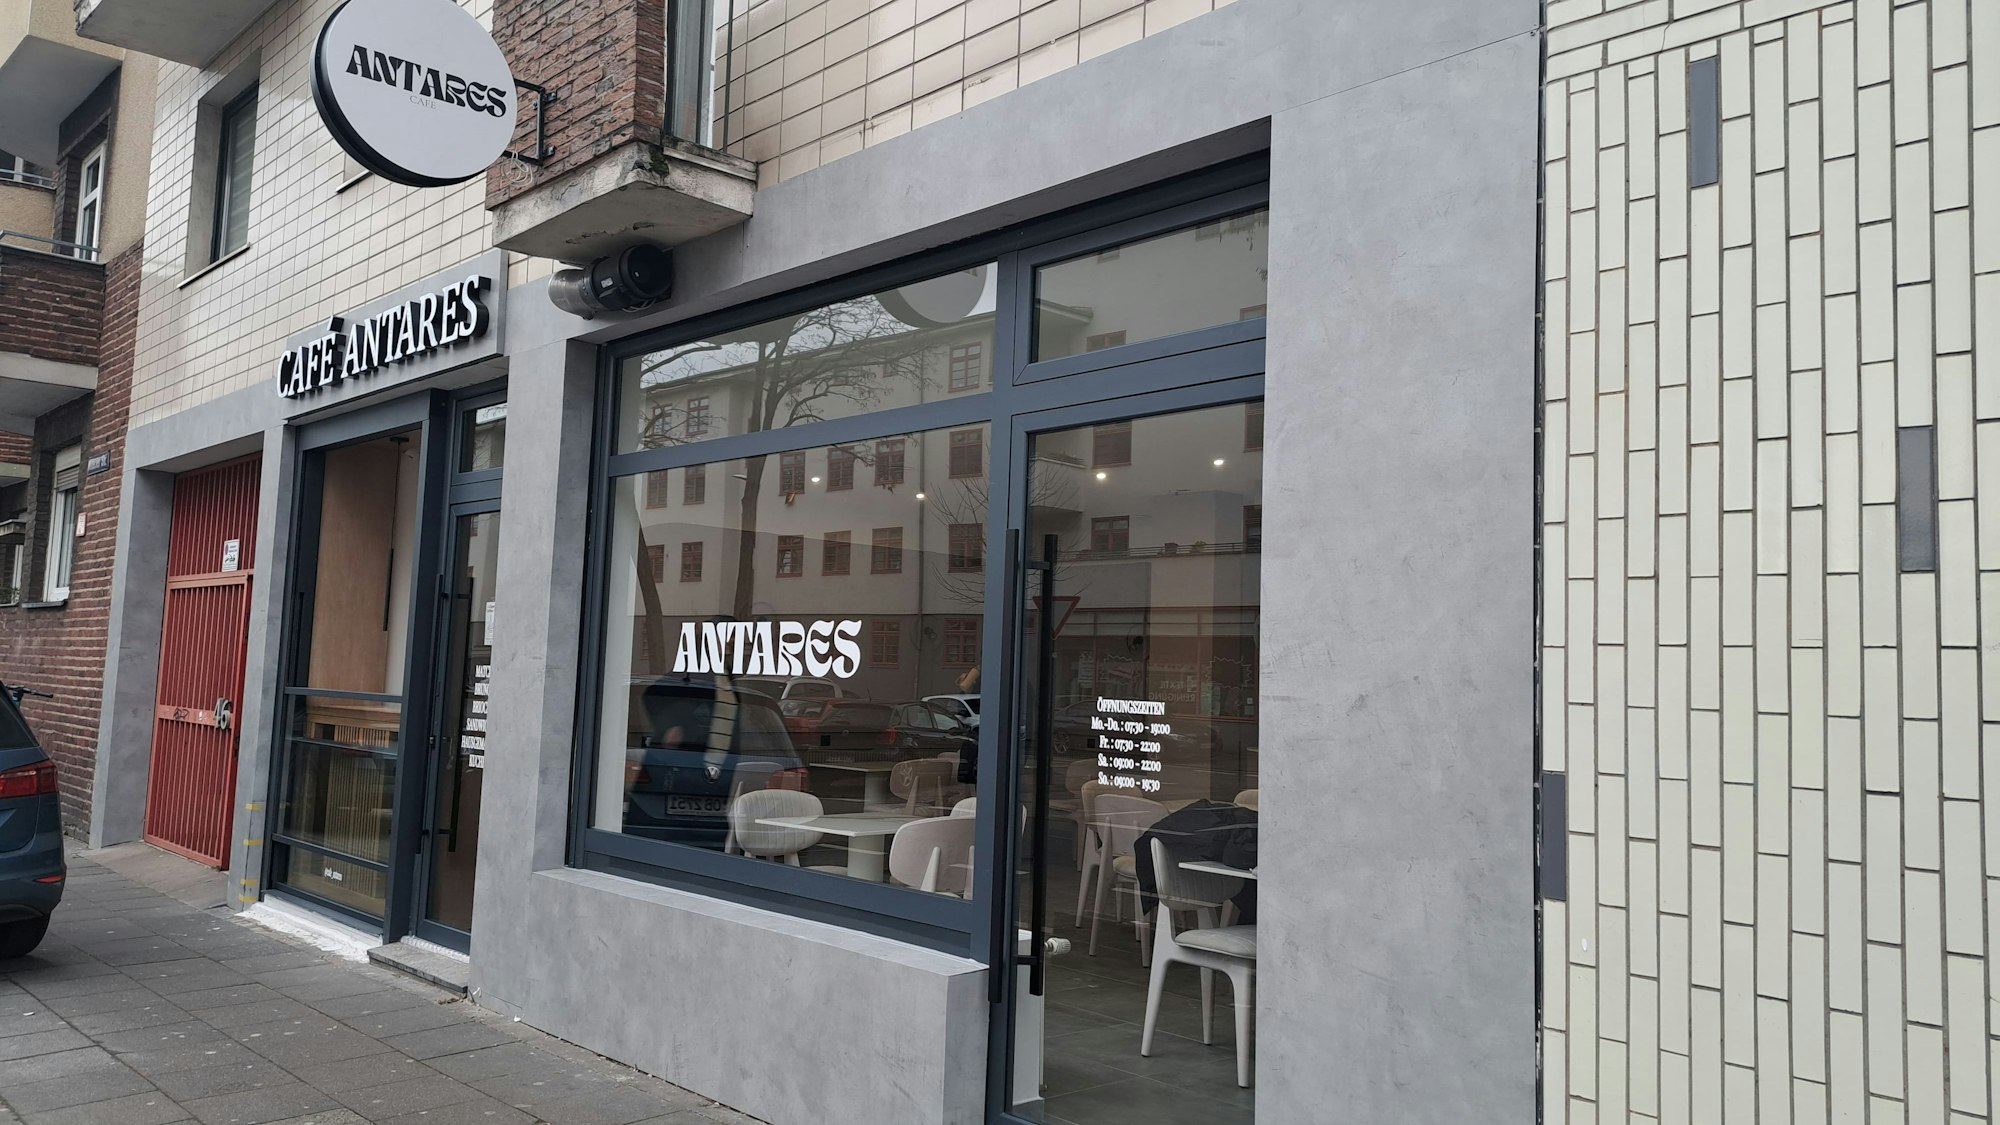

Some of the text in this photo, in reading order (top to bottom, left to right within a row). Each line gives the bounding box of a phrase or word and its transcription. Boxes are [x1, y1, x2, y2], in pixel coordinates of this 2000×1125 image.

[346, 44, 507, 118] ANTARES
[276, 274, 480, 399] CAFÉ ANTARES
[672, 619, 862, 679] ANTARES
[214, 697, 233, 730] 46
[1097, 696, 1166, 715] ÖFFNUNGSZEITEN
